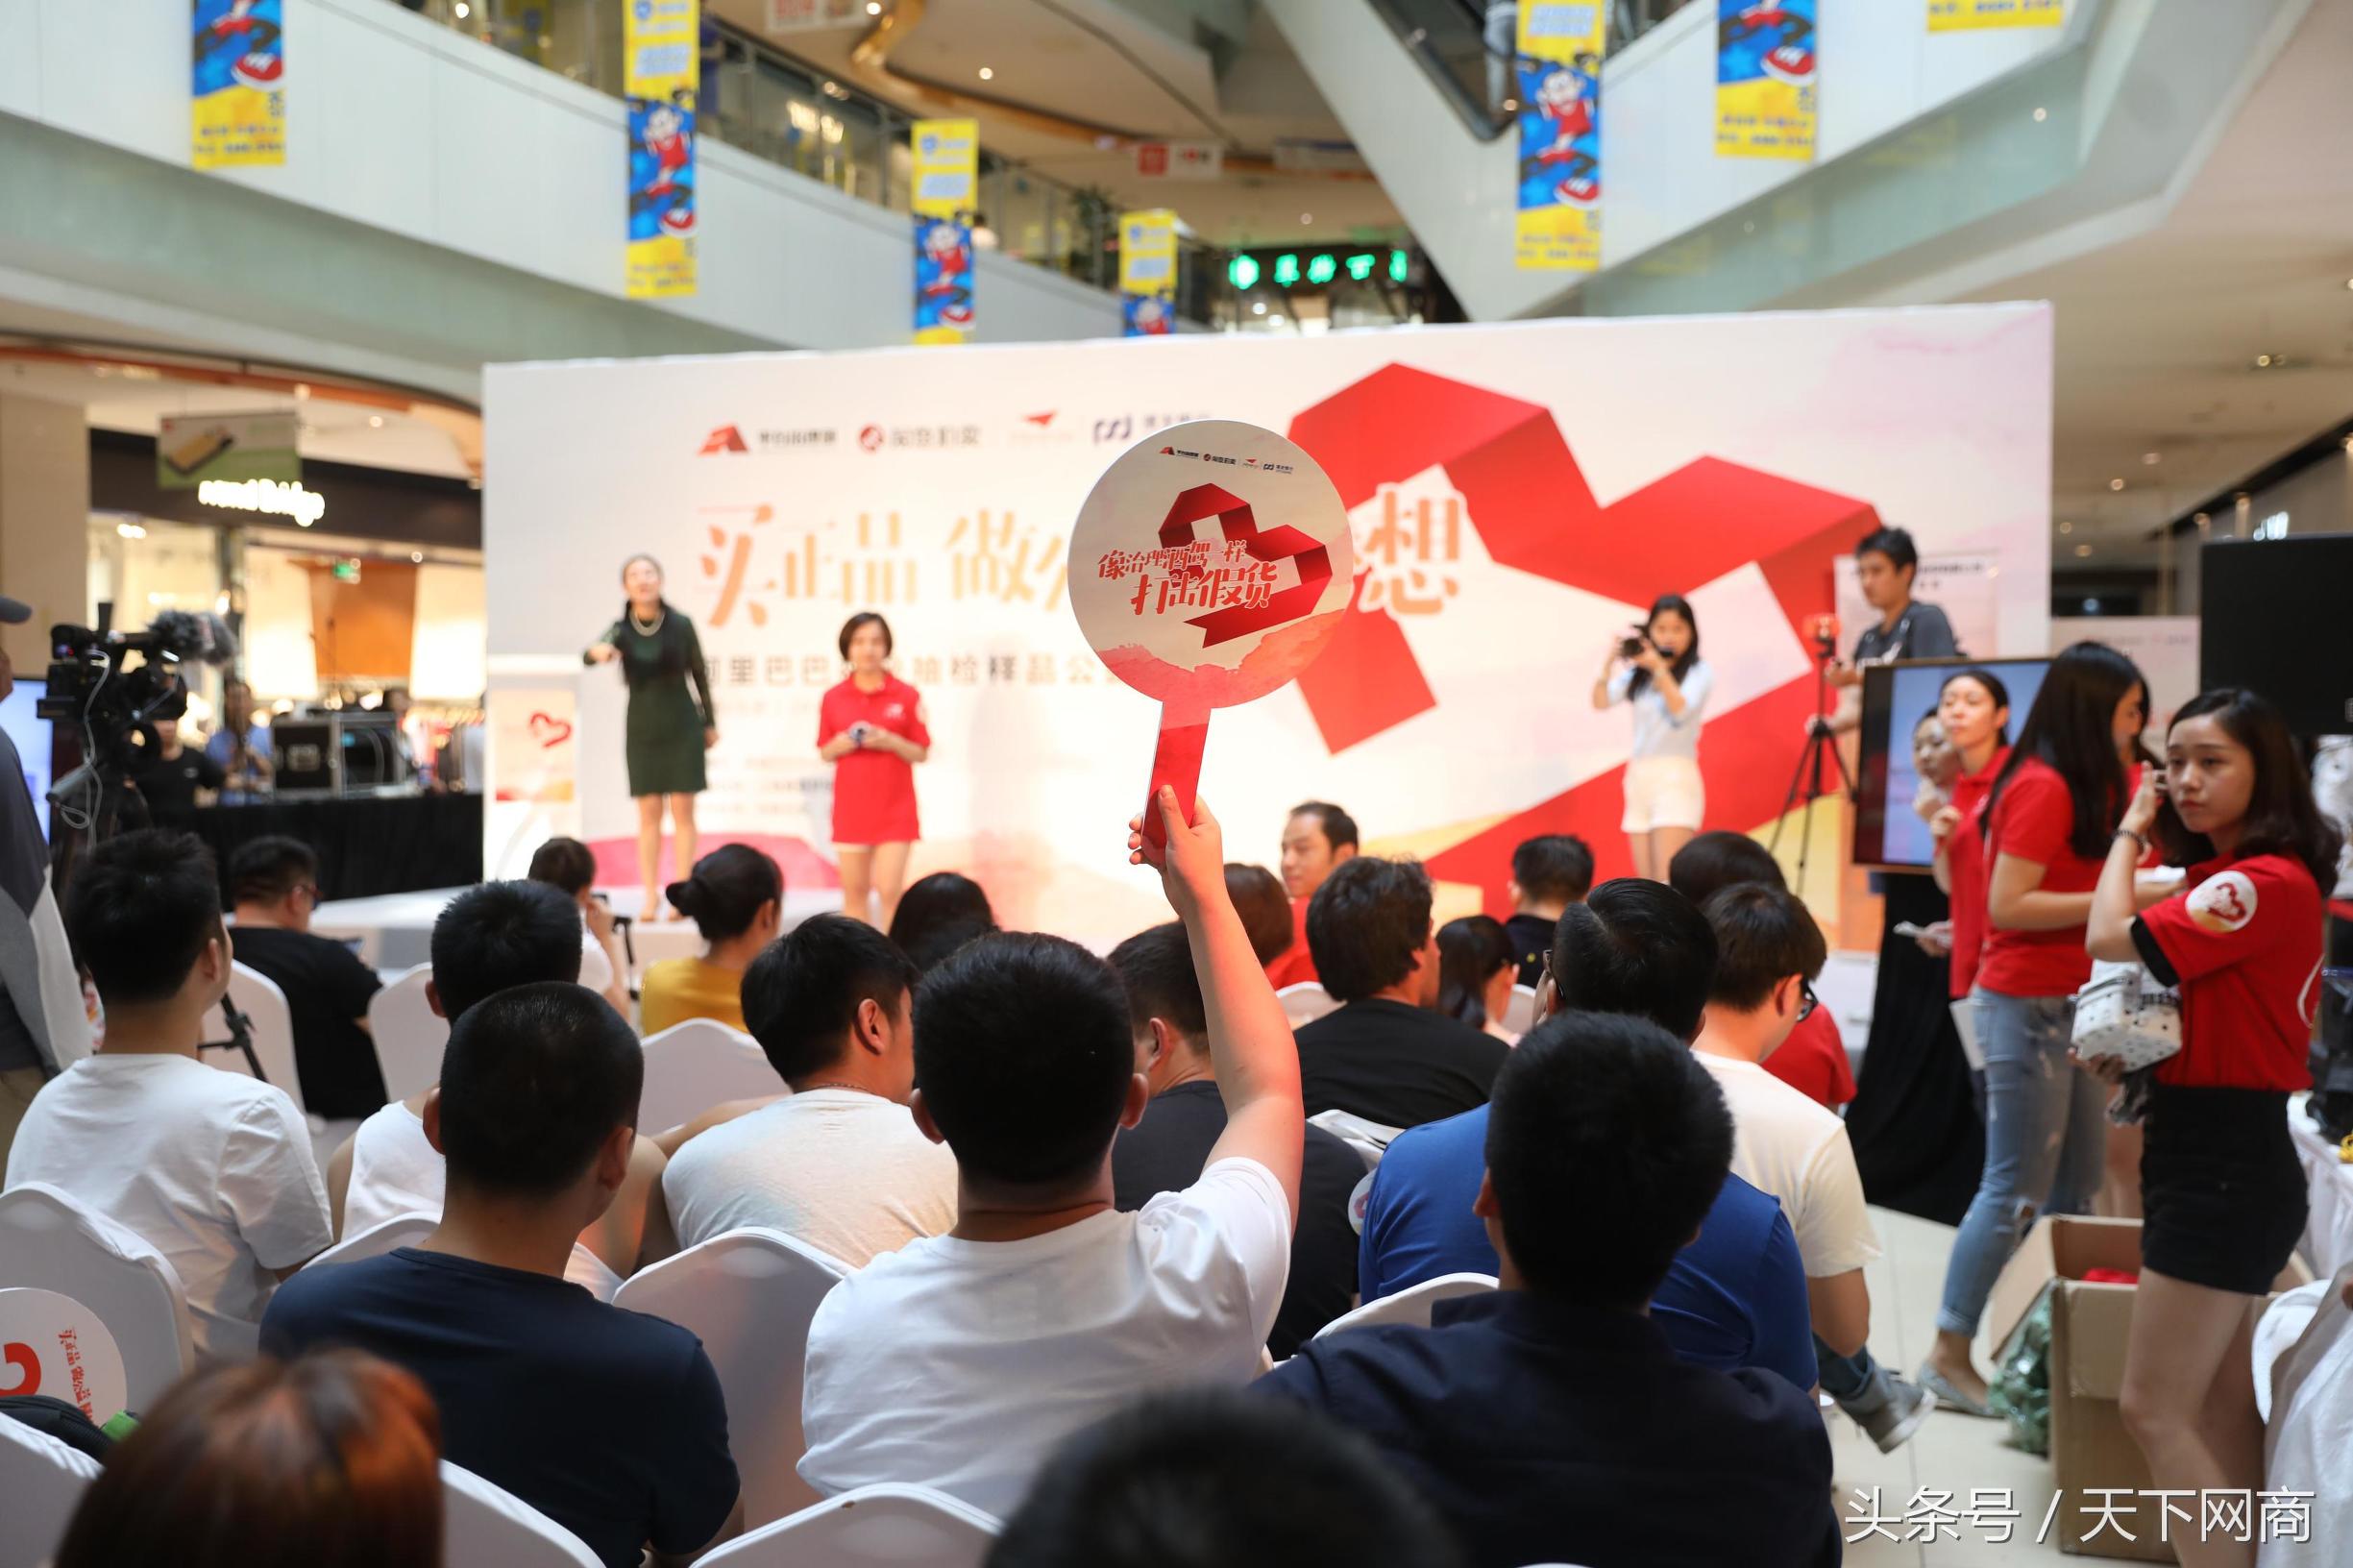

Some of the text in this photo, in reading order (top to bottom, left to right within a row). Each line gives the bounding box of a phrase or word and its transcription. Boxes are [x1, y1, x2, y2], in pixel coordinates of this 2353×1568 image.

[696, 502, 915, 627] 买正品
[1354, 488, 1460, 617] 想
[1097, 539, 1248, 580] 像治理酒驾一样
[1130, 561, 1279, 616] 打击假货
